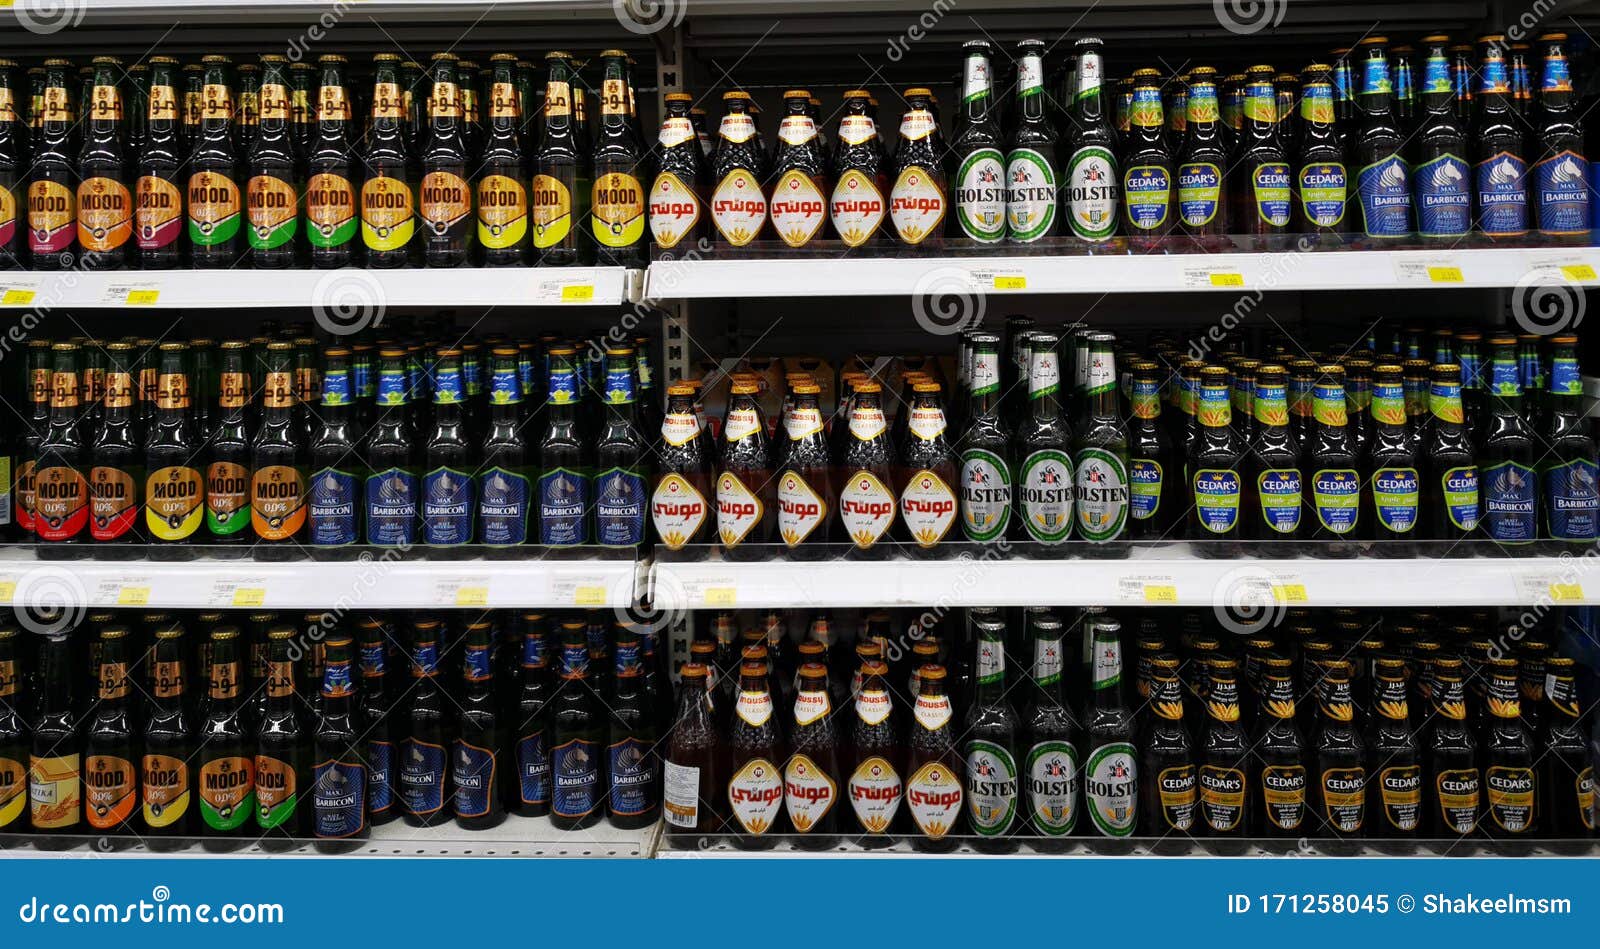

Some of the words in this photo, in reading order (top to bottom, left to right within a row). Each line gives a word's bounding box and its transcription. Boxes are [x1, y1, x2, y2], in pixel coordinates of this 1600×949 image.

[1128, 177, 1166, 187] CEDAR'S
[1304, 174, 1344, 184] CEDAR'S
[1197, 480, 1236, 489] CEDAR'S
[1263, 480, 1299, 489] CEDAR'S
[1317, 480, 1357, 490] CEDAR'S
[1377, 479, 1417, 489] CEDAR'S
[962, 487, 1010, 502] OLSTEN
[1077, 487, 1129, 503] OLSTEN
